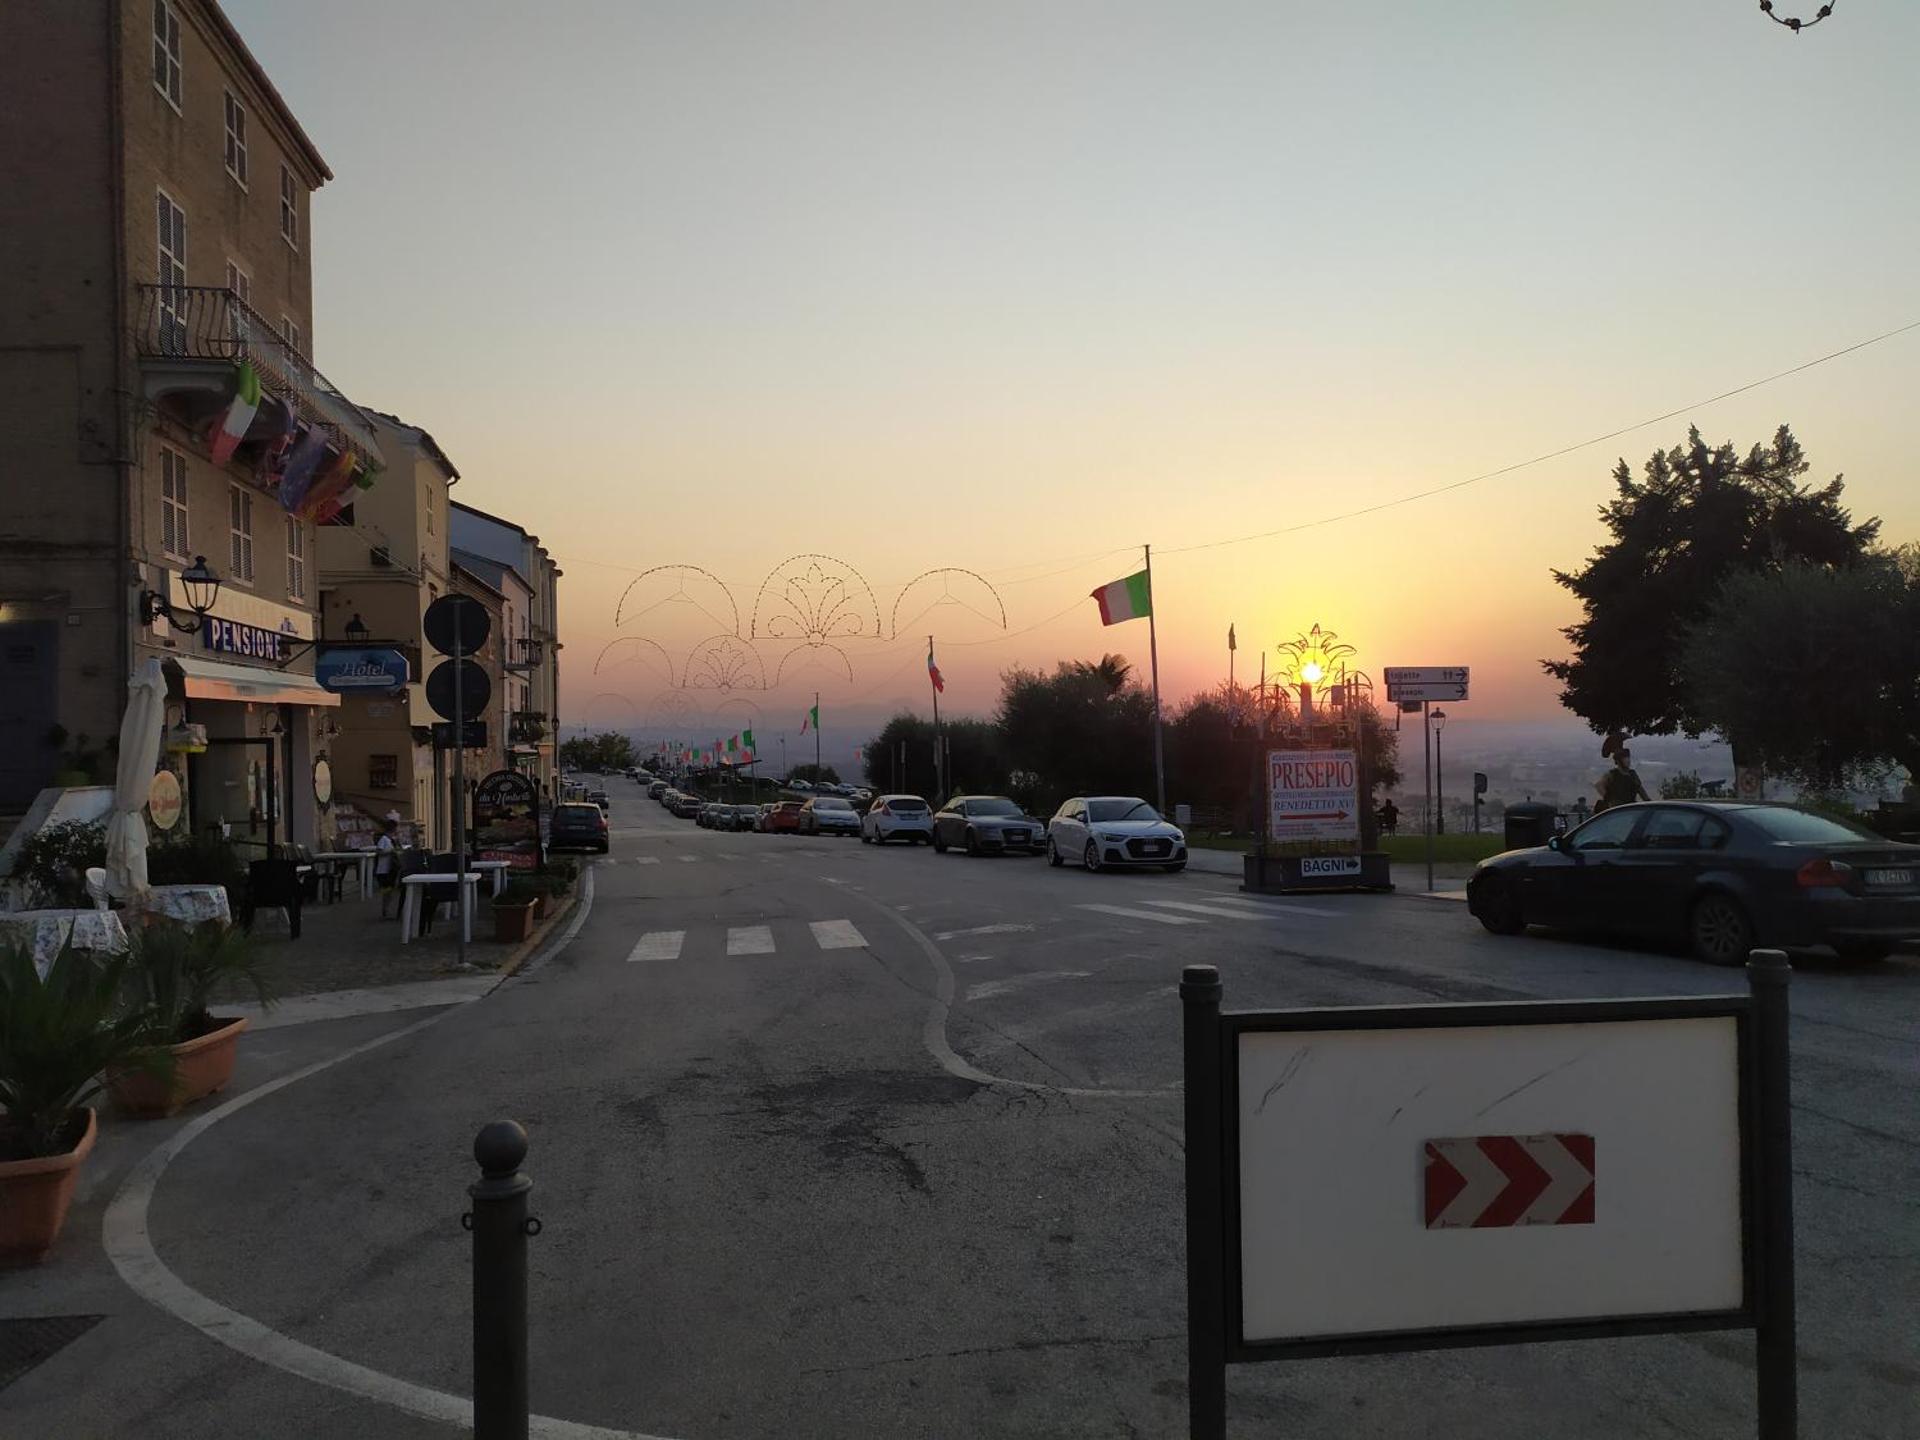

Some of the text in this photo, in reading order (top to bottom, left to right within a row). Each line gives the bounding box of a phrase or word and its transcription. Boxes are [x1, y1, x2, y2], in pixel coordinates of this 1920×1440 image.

[211, 618, 282, 661] PENSIONE
[1272, 761, 1354, 789] PRESEPIO
[1274, 799, 1335, 811] BENEDETTO
[1303, 859, 1345, 873] BAGNI
